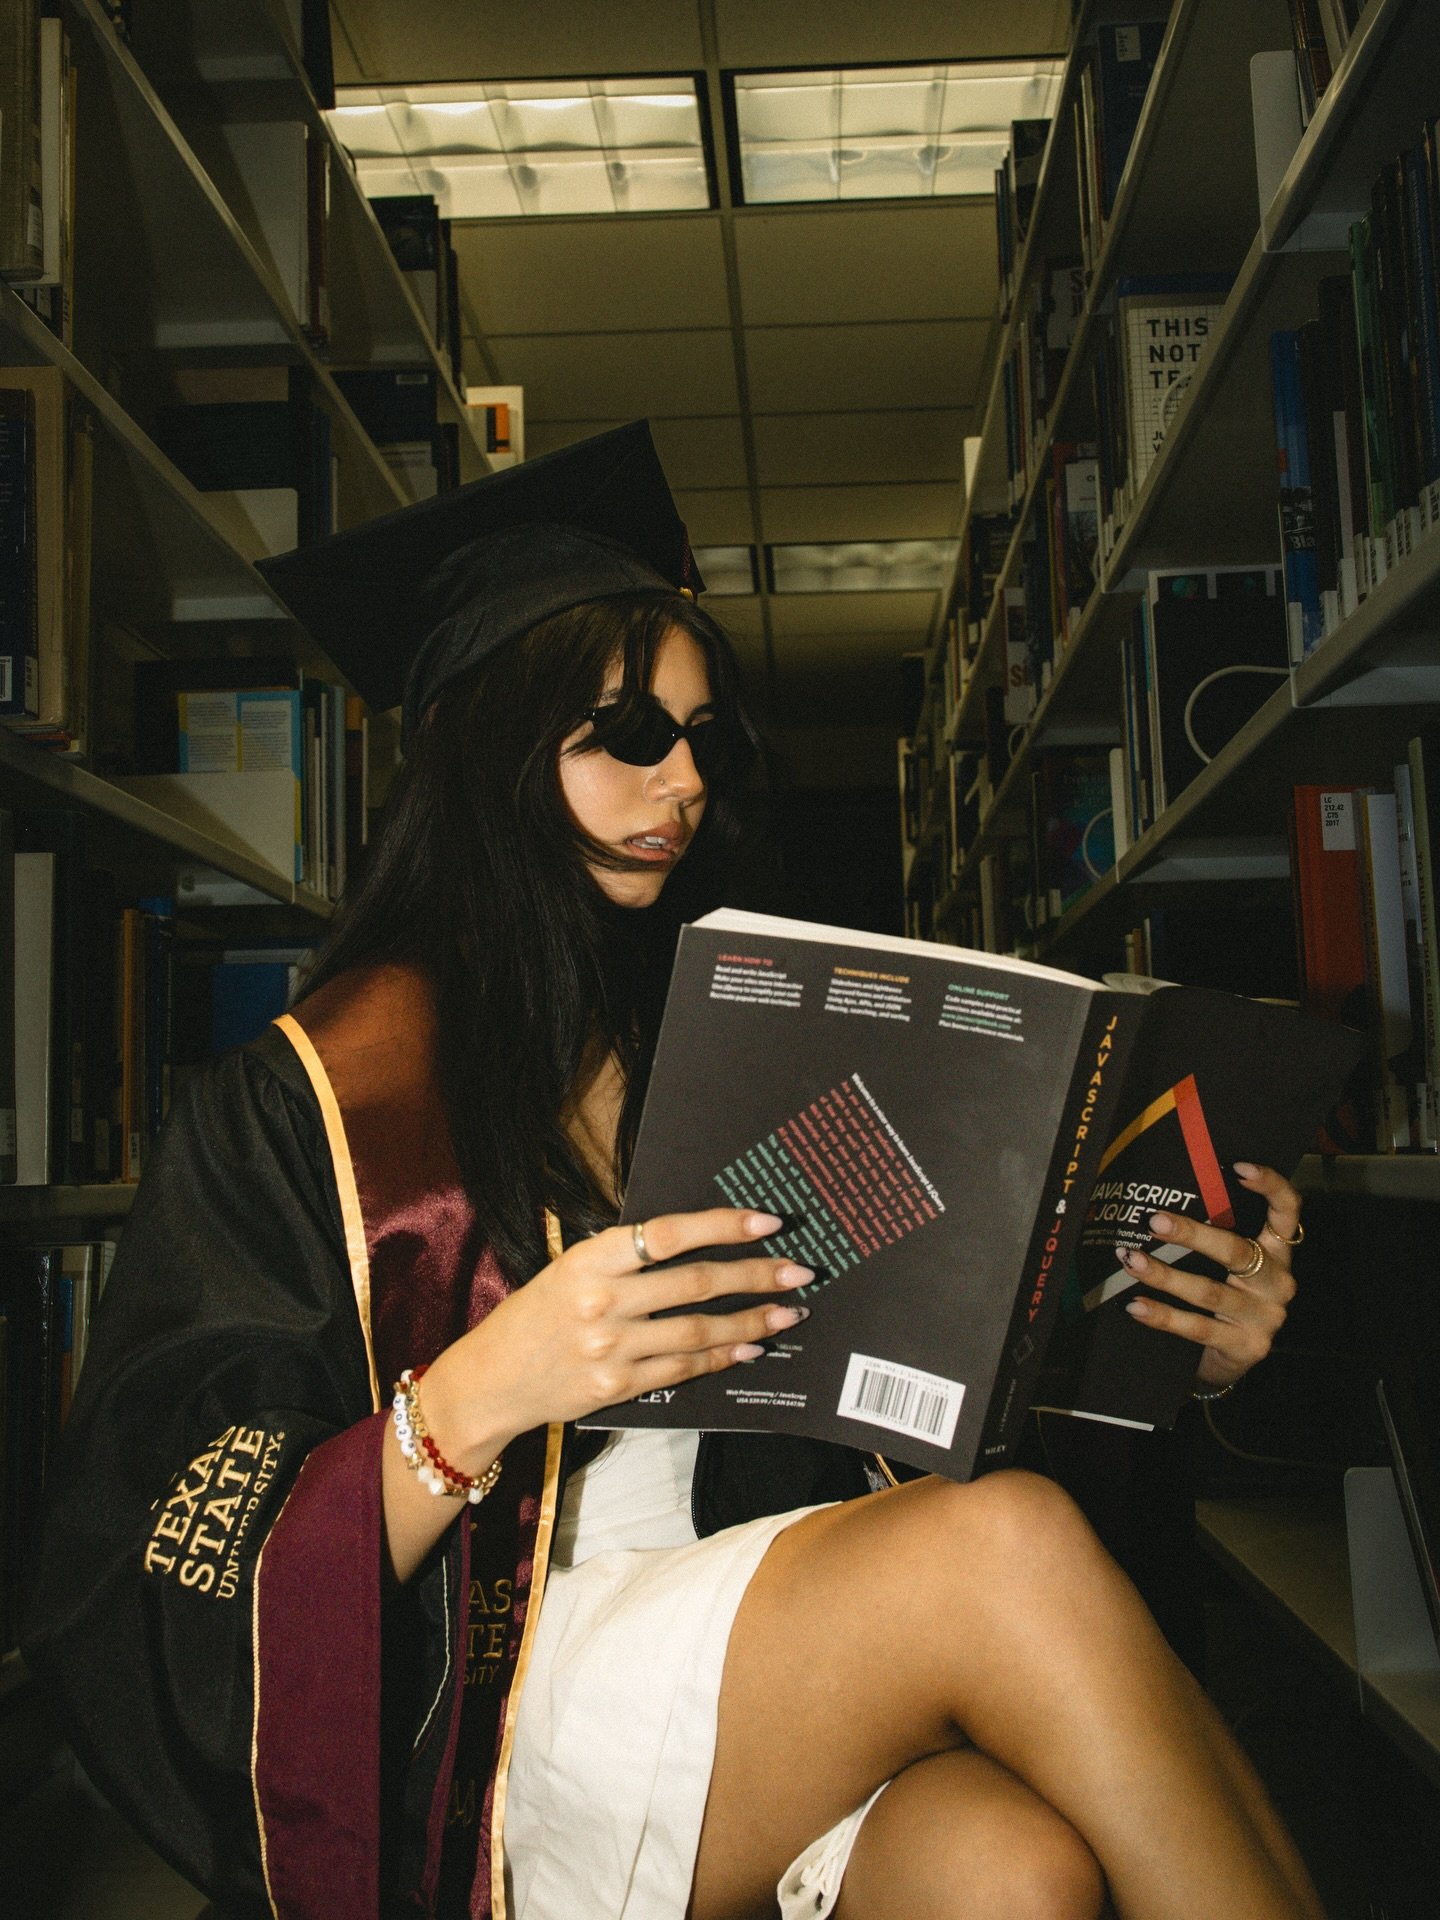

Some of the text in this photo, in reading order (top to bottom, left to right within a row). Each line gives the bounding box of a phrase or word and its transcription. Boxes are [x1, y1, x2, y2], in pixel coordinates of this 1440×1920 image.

[1147, 317, 1209, 337] THIS
[1150, 344, 1200, 363] NOT
[1028, 1015, 1118, 1323] JAVASCRIPT & JQUERY
[1091, 1182, 1196, 1211] JAVASCRIPT
[1094, 1203, 1158, 1224] JQUE
[1117, 1229, 1152, 1241] front-end
[636, 1390, 676, 1404] LEY
[180, 1426, 265, 1593] STATE
